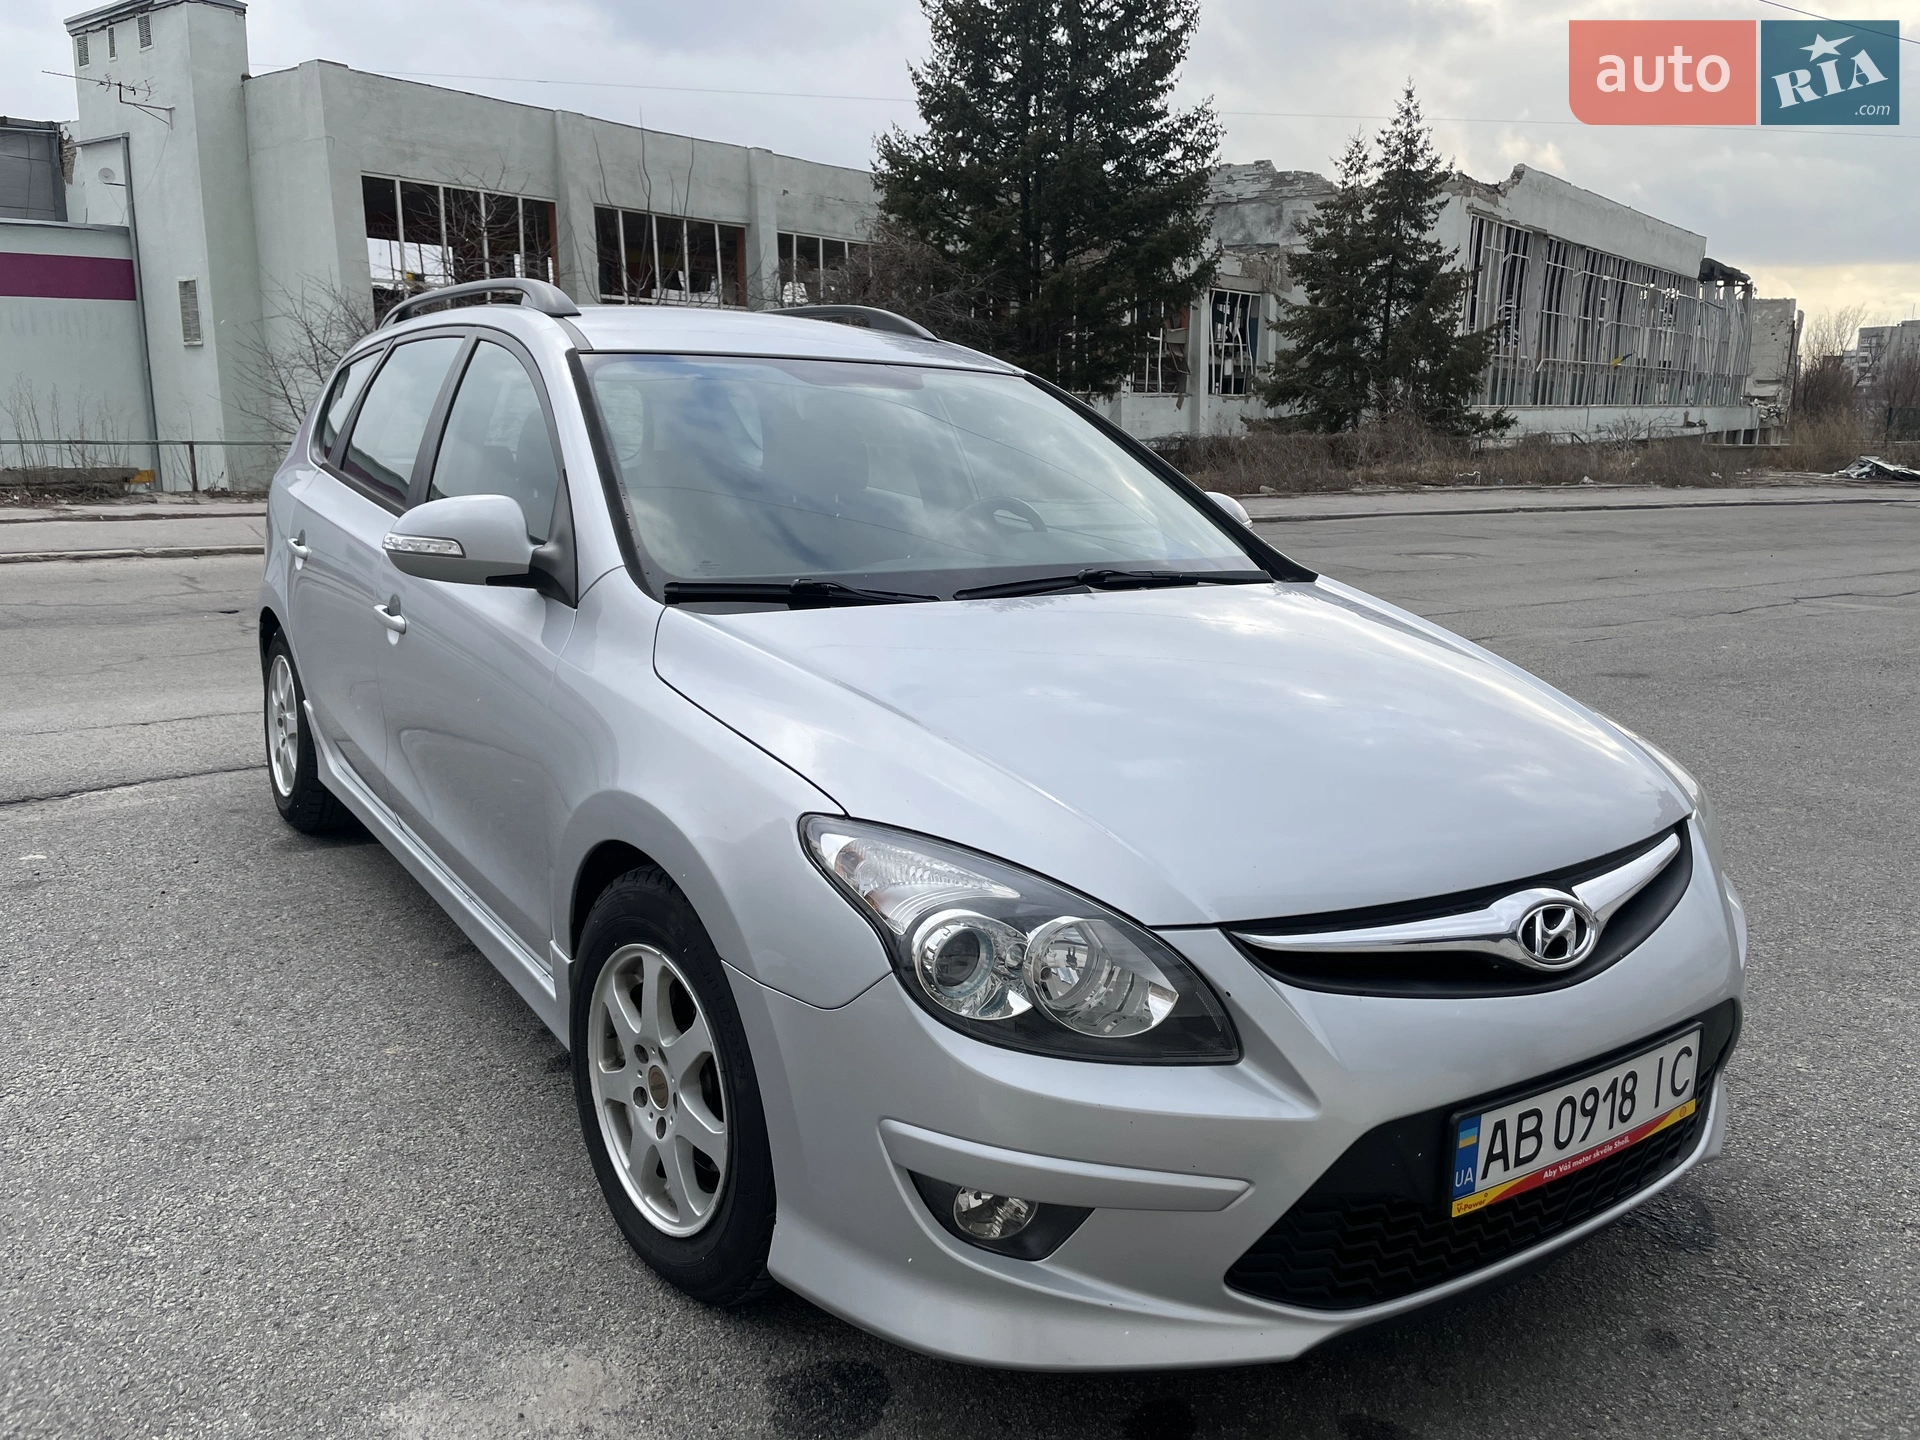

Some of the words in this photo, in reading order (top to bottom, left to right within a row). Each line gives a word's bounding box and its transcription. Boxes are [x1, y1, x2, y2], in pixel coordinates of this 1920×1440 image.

[1480, 1107, 1543, 1181] AB
[1553, 1070, 1638, 1151] 0918
[1654, 1046, 1692, 1109] IC
[1454, 1167, 1474, 1188] UA
[1543, 1168, 1558, 1180] Aby
[1558, 1161, 1572, 1173] Váš
[1572, 1153, 1592, 1168] motor
[1456, 1198, 1487, 1214] V-Power
